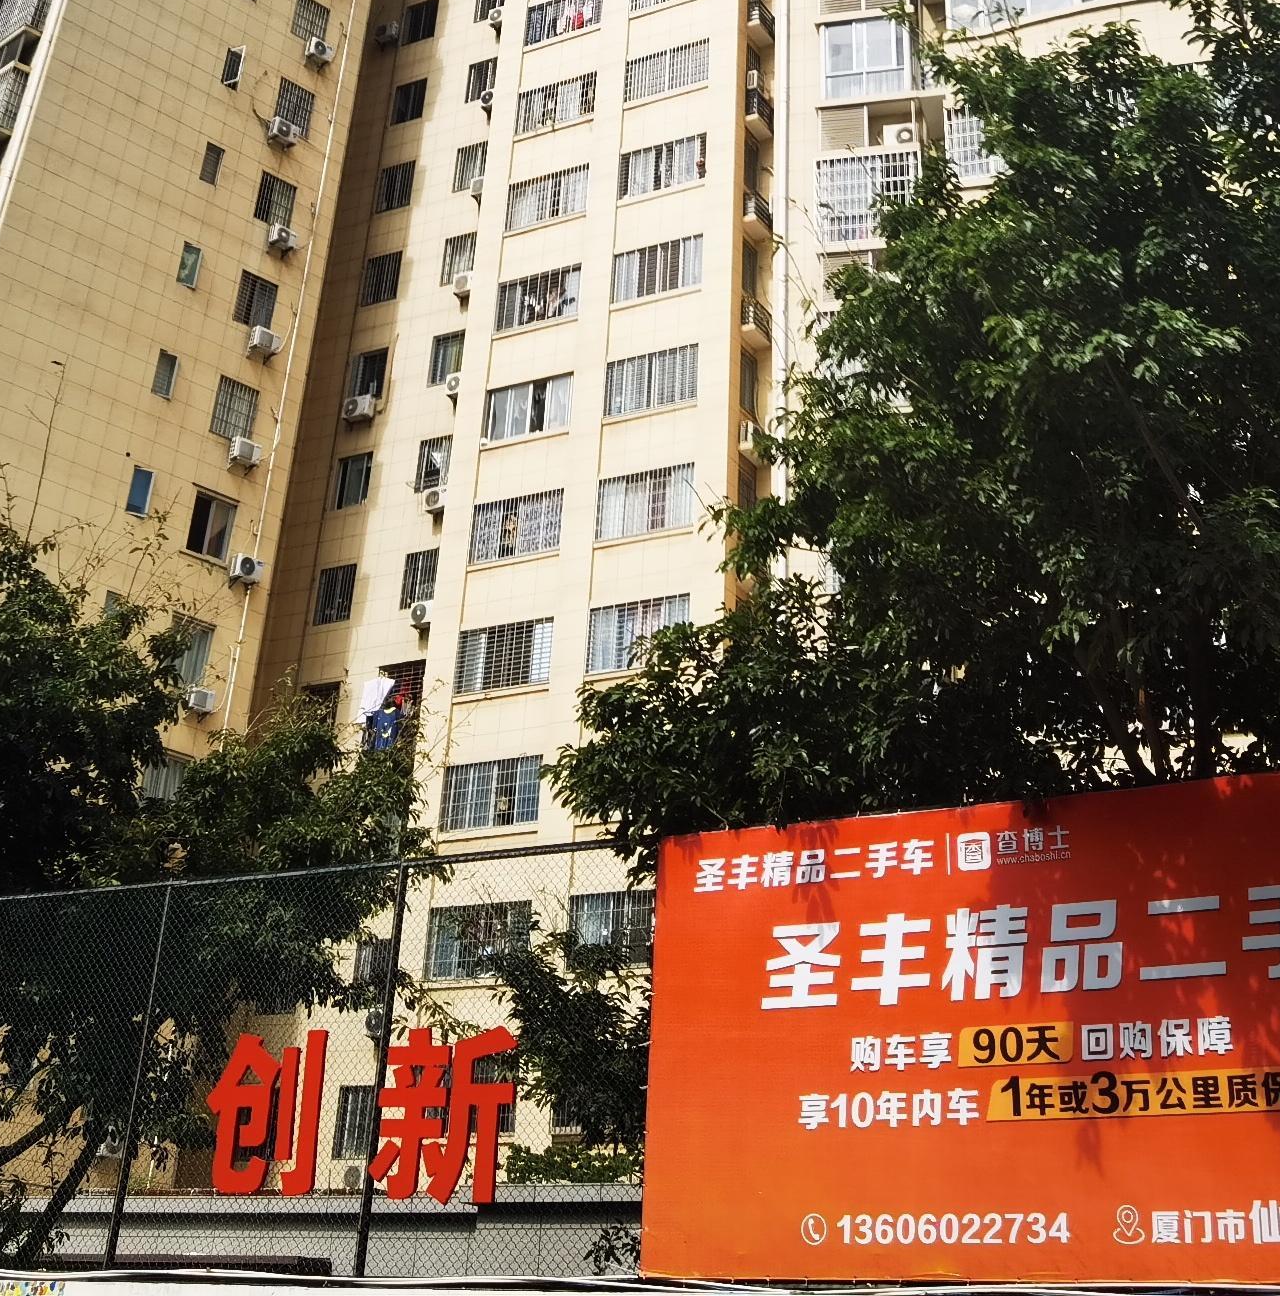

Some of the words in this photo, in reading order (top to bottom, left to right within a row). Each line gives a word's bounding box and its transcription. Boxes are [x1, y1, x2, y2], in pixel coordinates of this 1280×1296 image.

[996, 825, 1070, 855] 查博士
[694, 839, 934, 892] 圣丰精品二手车
[850, 1032, 953, 1072] 购车享
[972, 1026, 1061, 1064] 90天
[1080, 1016, 1234, 1061] 回购保障
[206, 1026, 519, 1204] 创新
[798, 1089, 980, 1130] 享10年内车
[836, 1212, 1071, 1245] 13606022734
